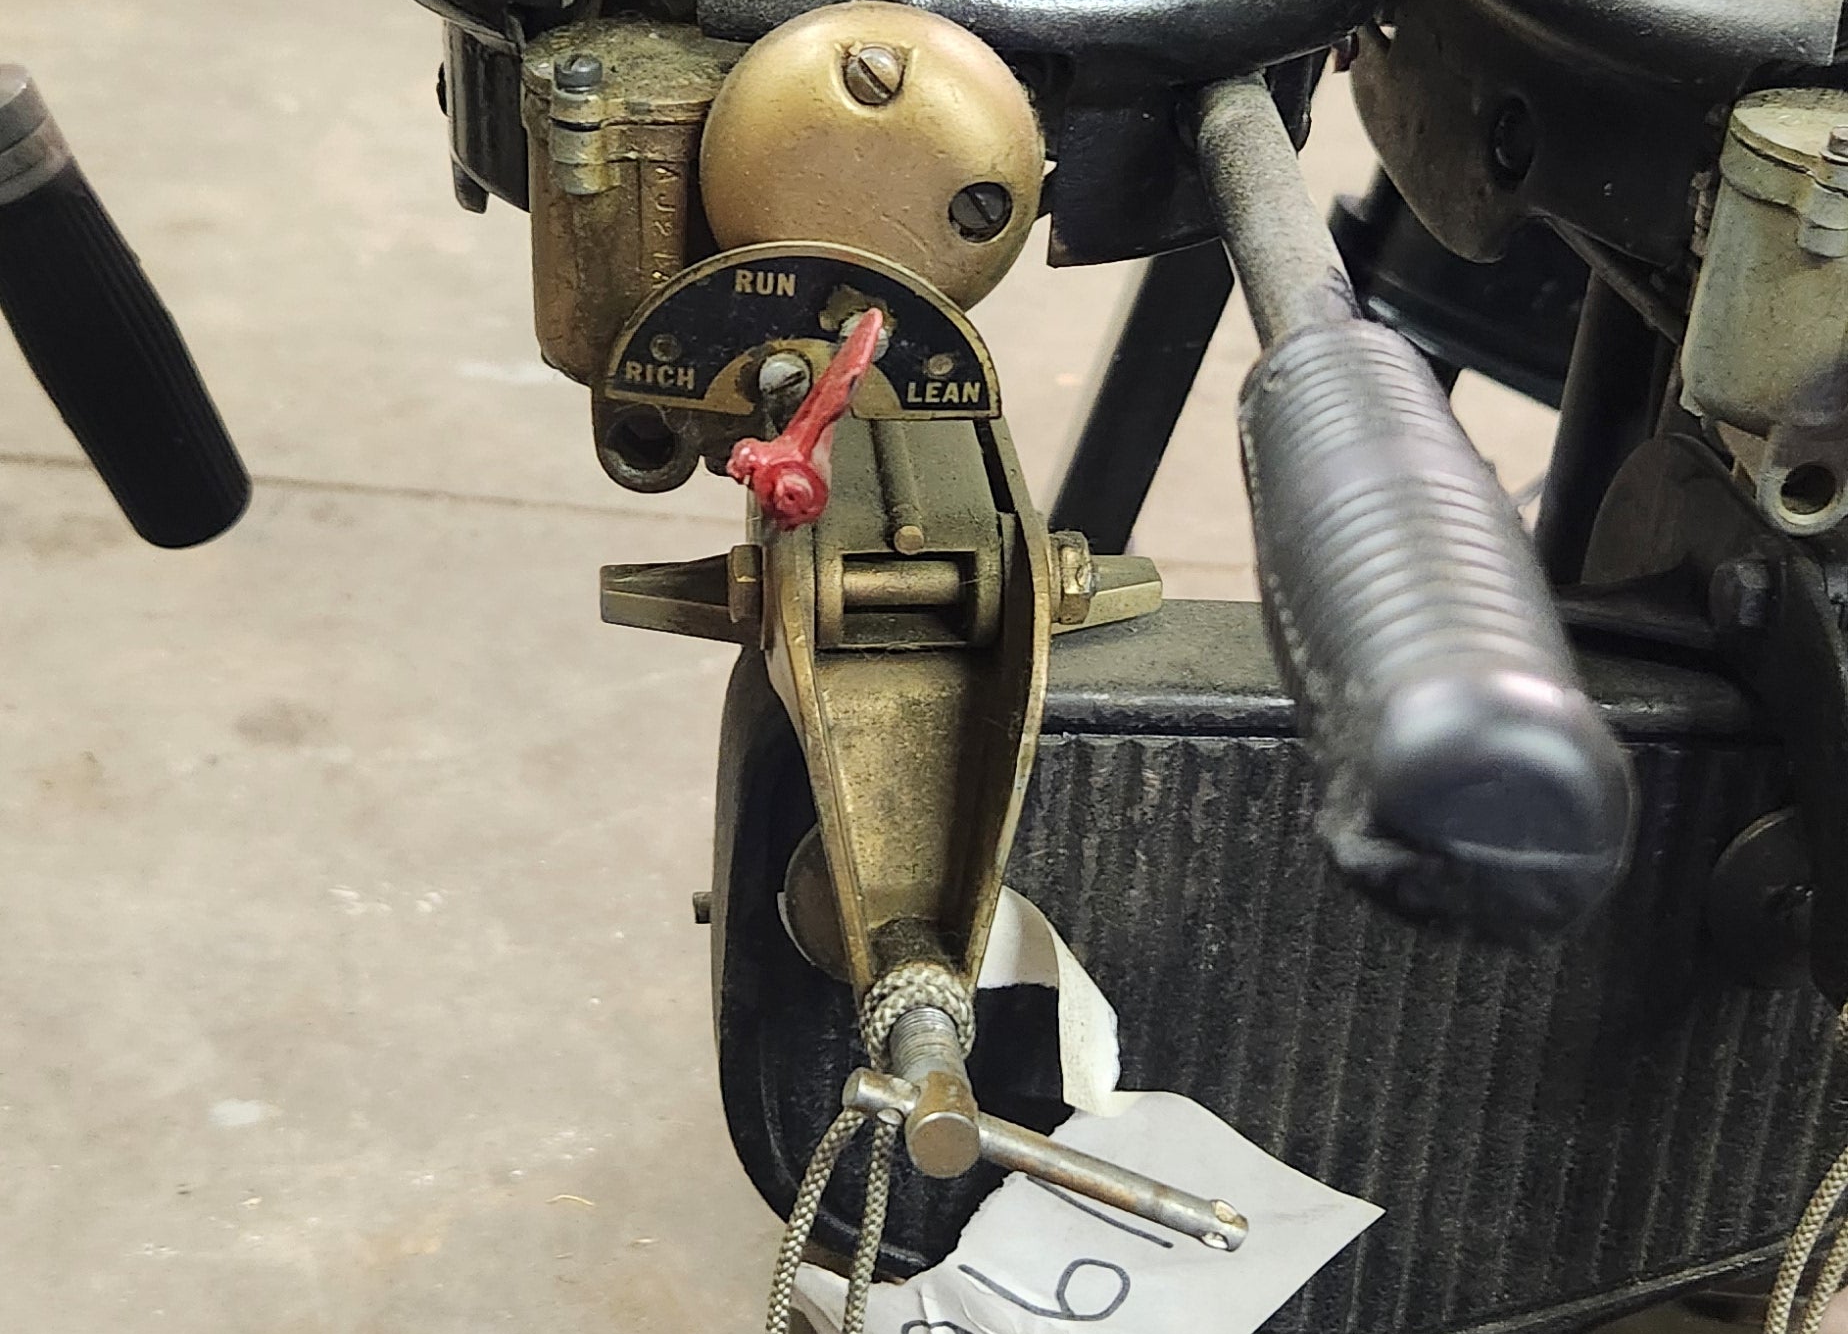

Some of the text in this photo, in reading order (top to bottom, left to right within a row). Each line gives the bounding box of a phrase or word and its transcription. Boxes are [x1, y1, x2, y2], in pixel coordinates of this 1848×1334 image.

[735, 269, 797, 298] RUN
[624, 360, 696, 391] RICH
[906, 380, 982, 405] LEAN
